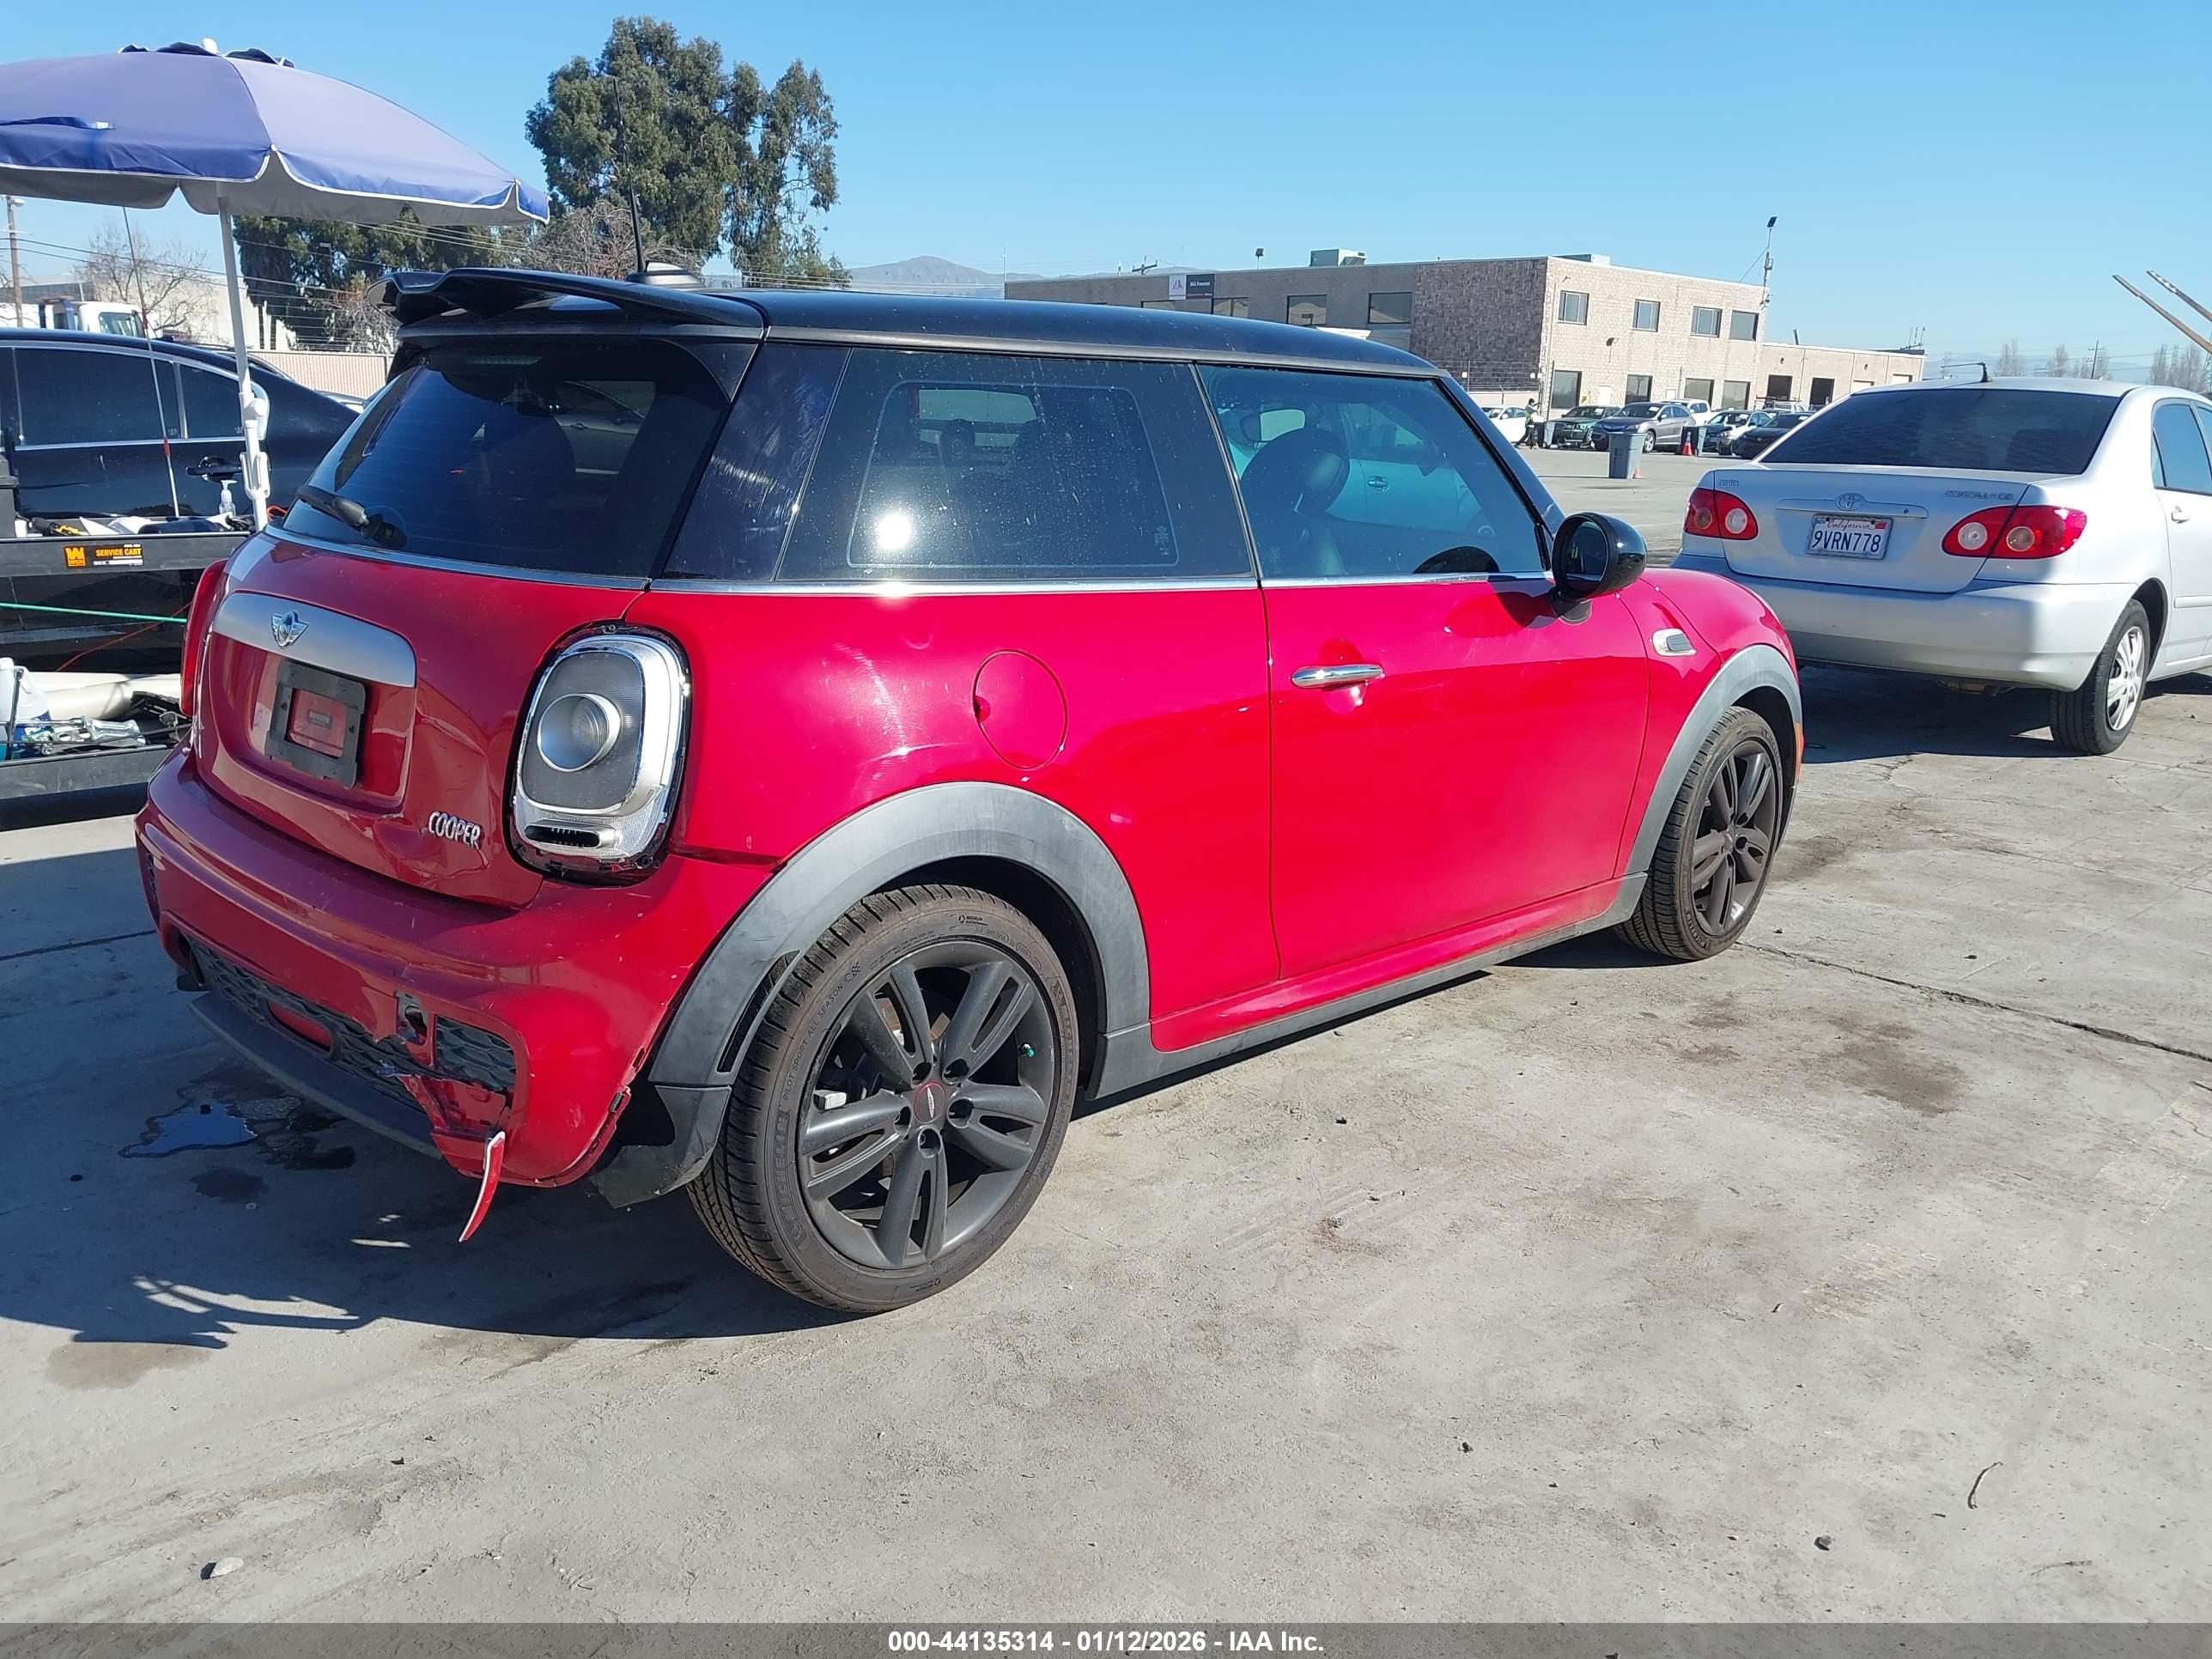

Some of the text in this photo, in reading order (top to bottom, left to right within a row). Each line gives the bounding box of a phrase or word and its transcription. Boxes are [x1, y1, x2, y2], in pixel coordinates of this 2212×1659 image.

[1827, 519, 1870, 531] California
[1812, 531, 1881, 552] 9VRN778
[428, 811, 481, 849] COOPER
[783, 982, 843, 1101] PILOT SPORT ALL SEASON
